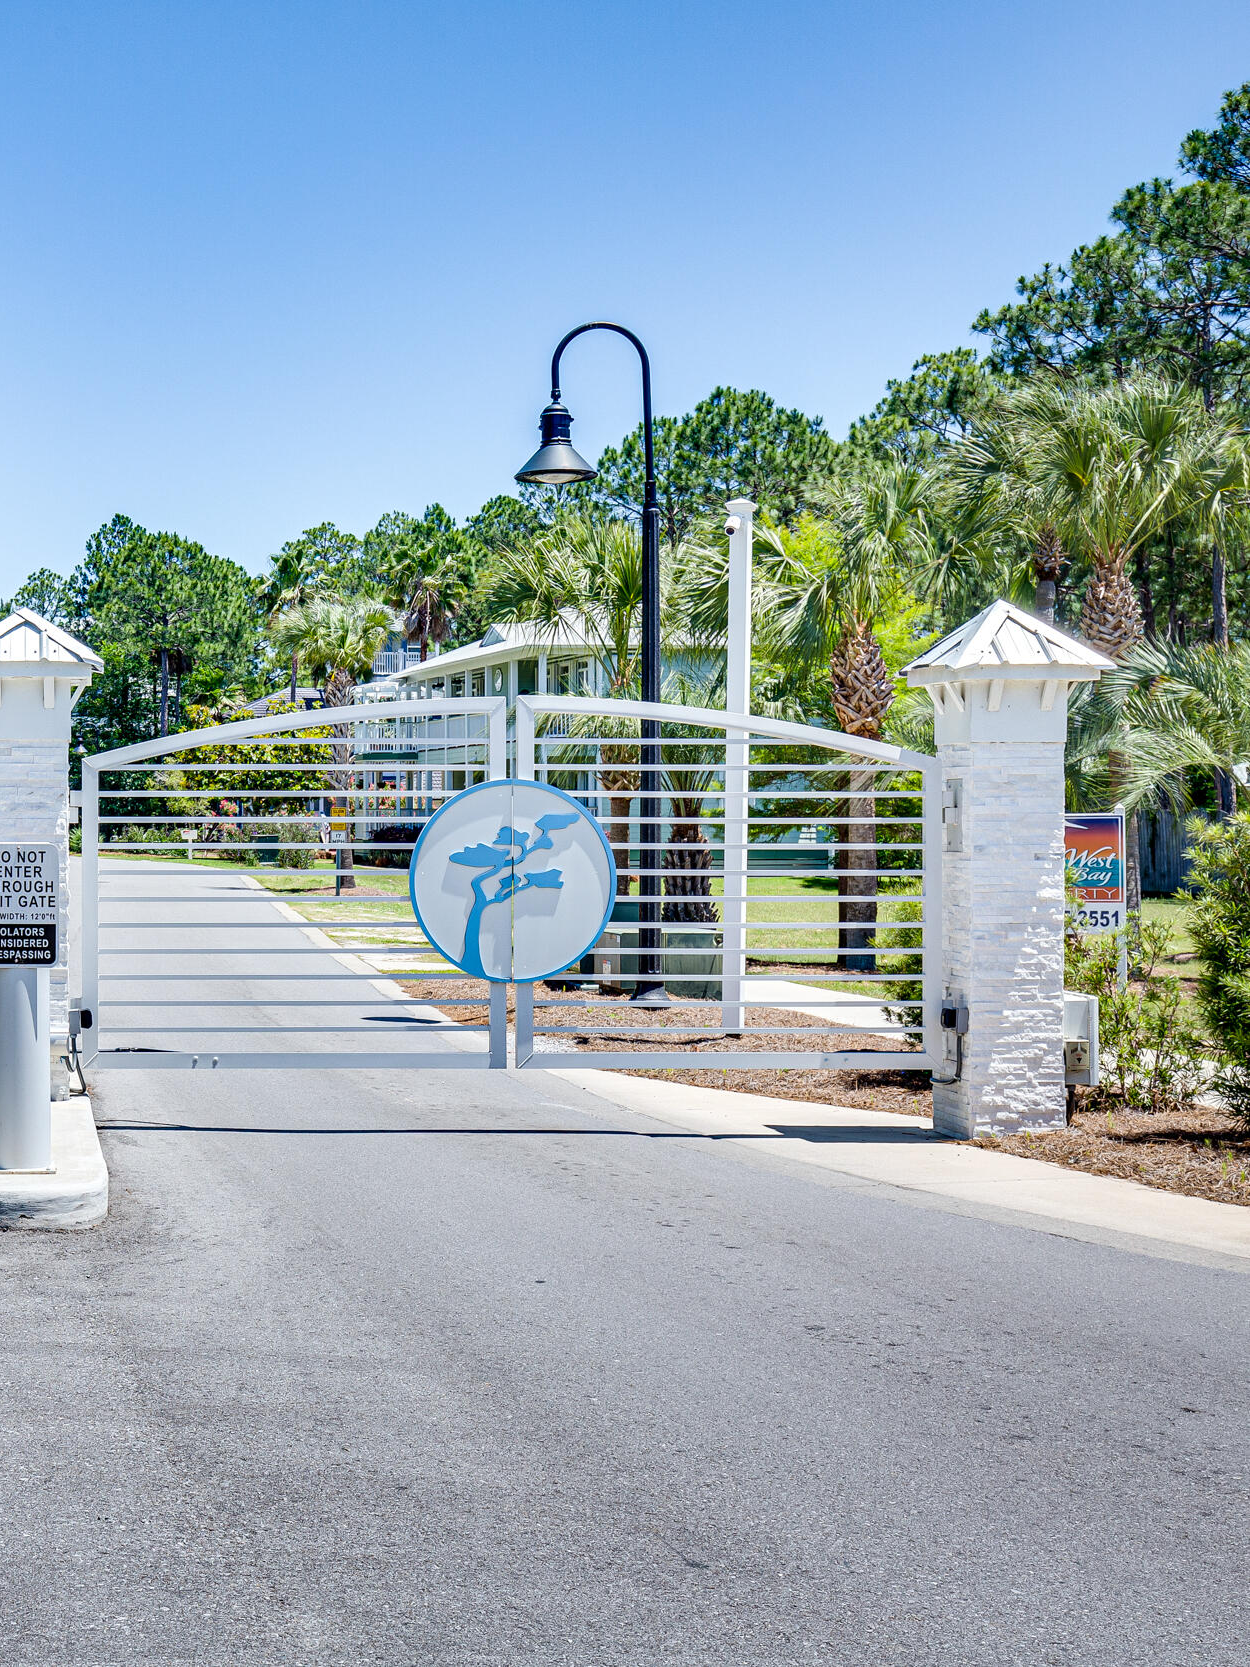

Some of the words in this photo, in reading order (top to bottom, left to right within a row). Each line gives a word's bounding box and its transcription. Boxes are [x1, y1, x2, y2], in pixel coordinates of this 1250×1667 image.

[17, 851, 46, 863] NOT
[1065, 846, 1117, 868] West
[1070, 867, 1112, 886] Bay
[18, 895, 56, 907] GATE
